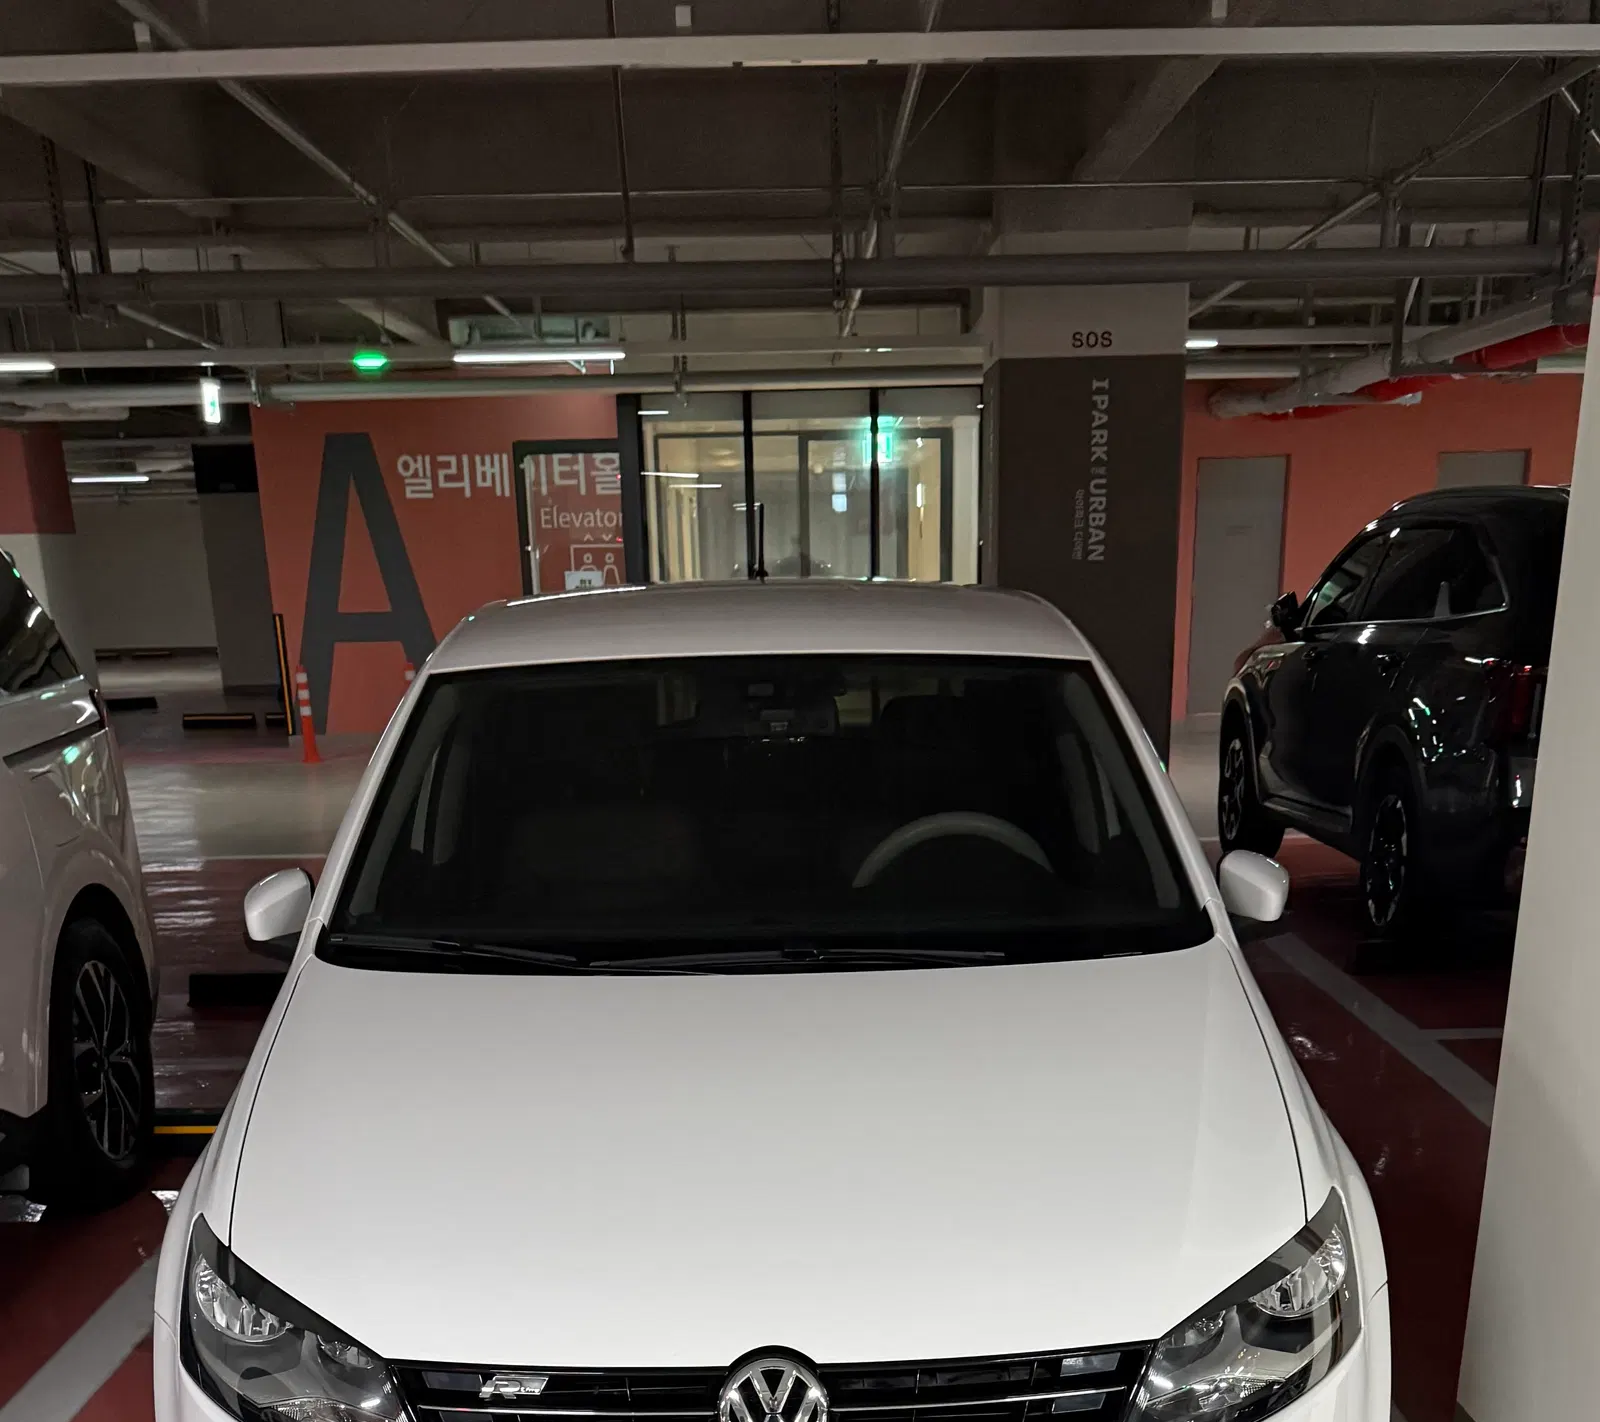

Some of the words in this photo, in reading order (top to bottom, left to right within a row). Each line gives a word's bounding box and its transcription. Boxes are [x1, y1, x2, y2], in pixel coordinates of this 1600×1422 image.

[1072, 331, 1112, 348] SOS
[1087, 479, 1107, 561] URBAN
[296, 432, 437, 735] A
